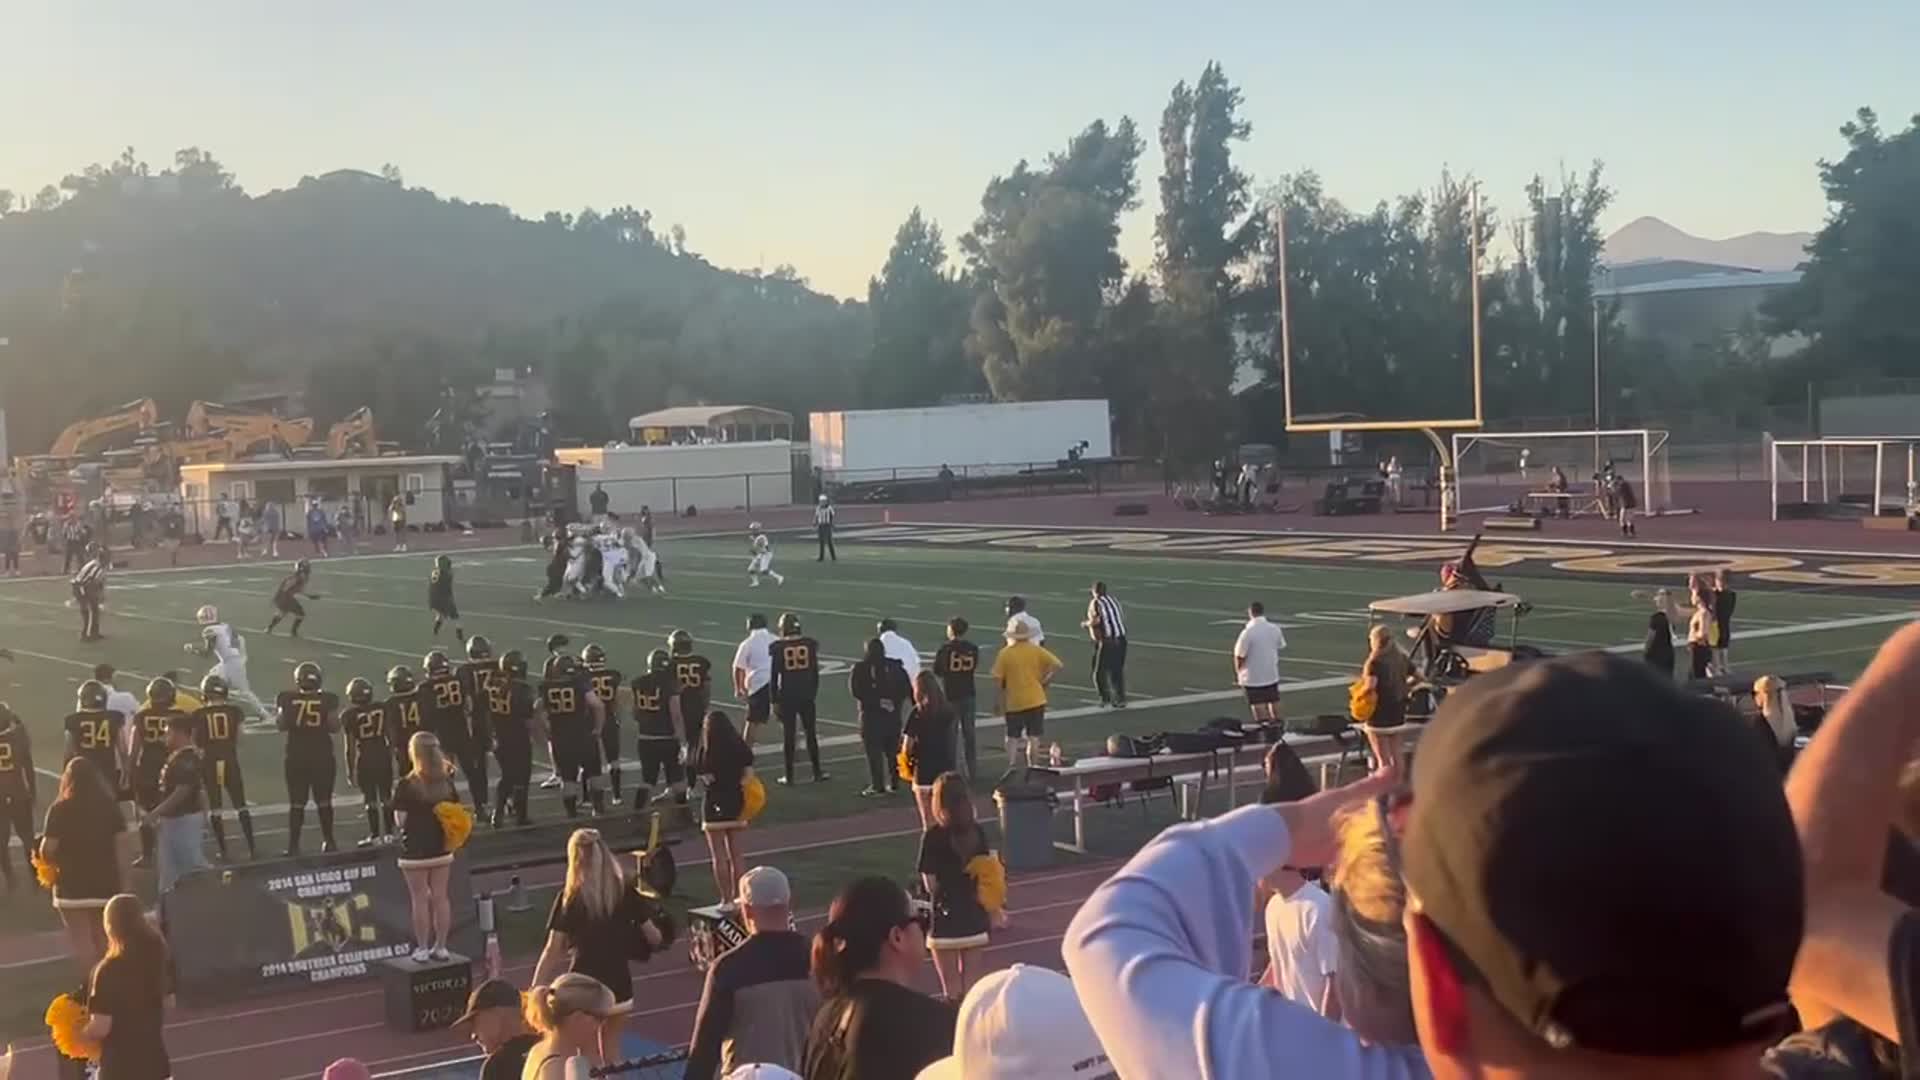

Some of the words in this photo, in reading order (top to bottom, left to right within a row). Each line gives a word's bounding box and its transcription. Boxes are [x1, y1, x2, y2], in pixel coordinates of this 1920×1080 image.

[433, 681, 461, 708] 28
[207, 712, 230, 740] 10
[292, 700, 322, 727] 75
[357, 710, 384, 738] 27
[399, 703, 421, 727] 14
[80, 719, 110, 748] 34
[268, 876, 293, 891] 2014
